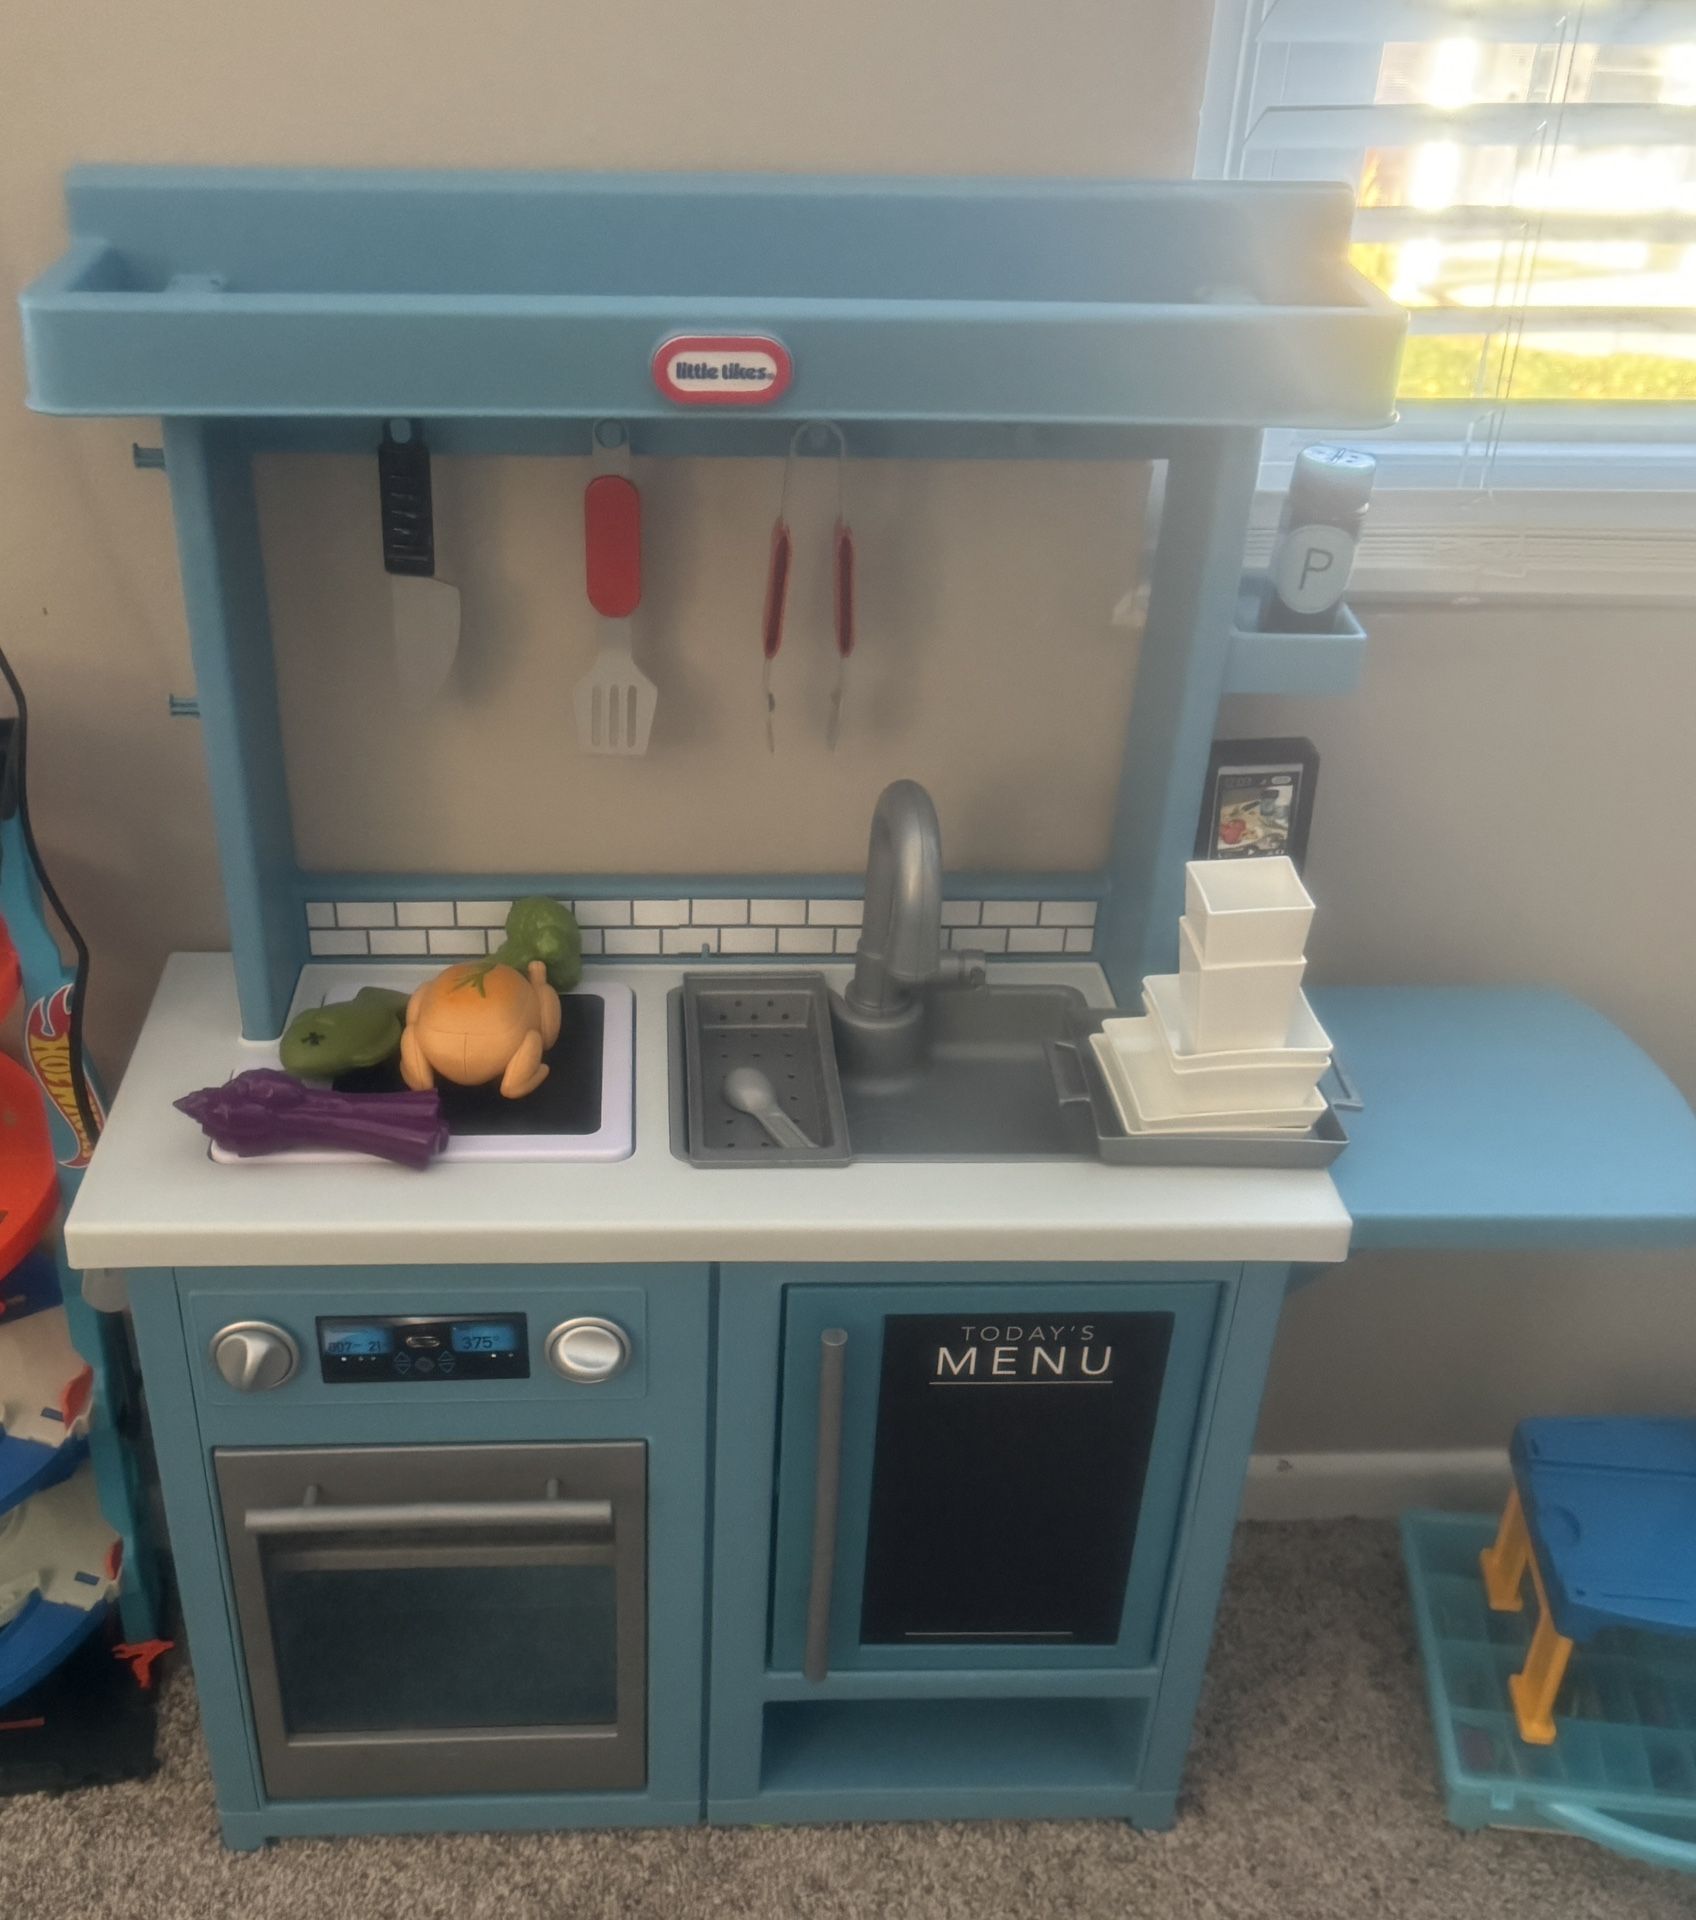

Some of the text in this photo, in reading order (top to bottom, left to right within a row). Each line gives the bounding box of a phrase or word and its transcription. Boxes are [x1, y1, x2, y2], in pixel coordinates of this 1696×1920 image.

[676, 362, 718, 379] little
[1298, 547, 1334, 590] P
[961, 1325, 1096, 1341] TODAY'S
[936, 1346, 1112, 1375] MENU
